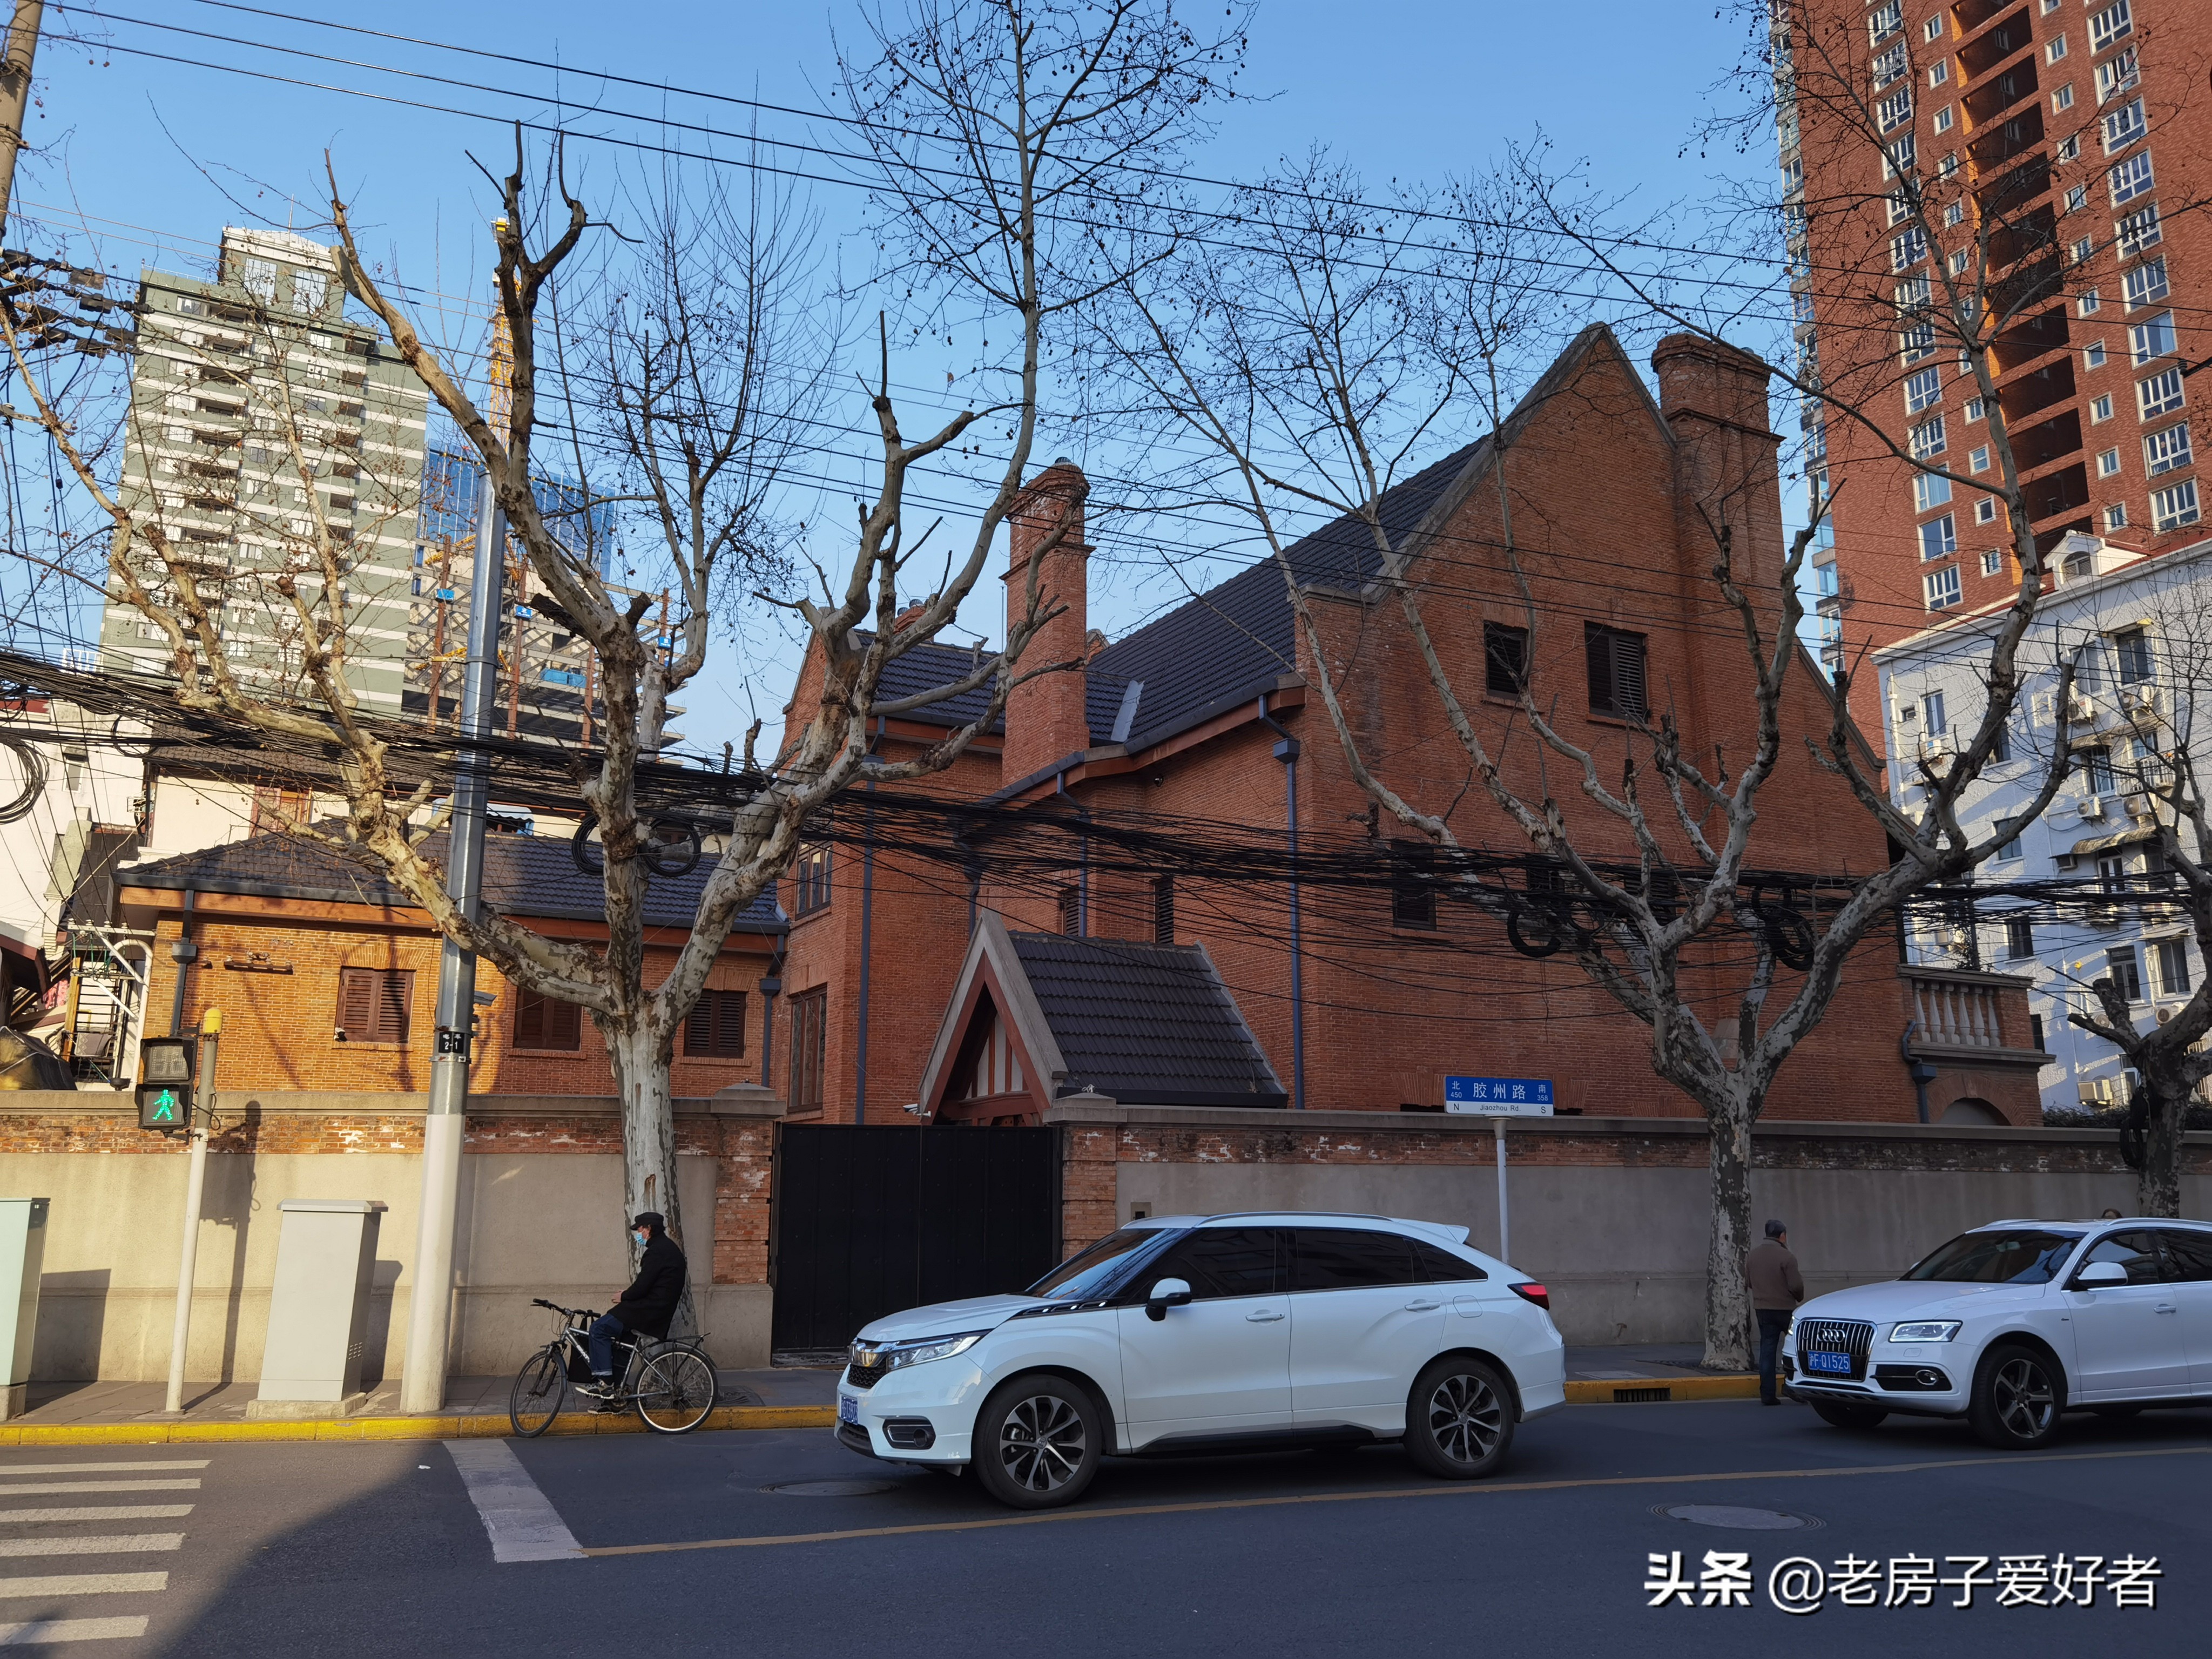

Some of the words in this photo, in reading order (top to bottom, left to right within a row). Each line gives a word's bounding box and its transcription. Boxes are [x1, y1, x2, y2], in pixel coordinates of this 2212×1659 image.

[444, 1041, 458, 1050] 2-1
[1452, 1081, 1460, 1090] 北
[1538, 1084, 1546, 1094] 南
[1473, 1082, 1526, 1100] 胶州路
